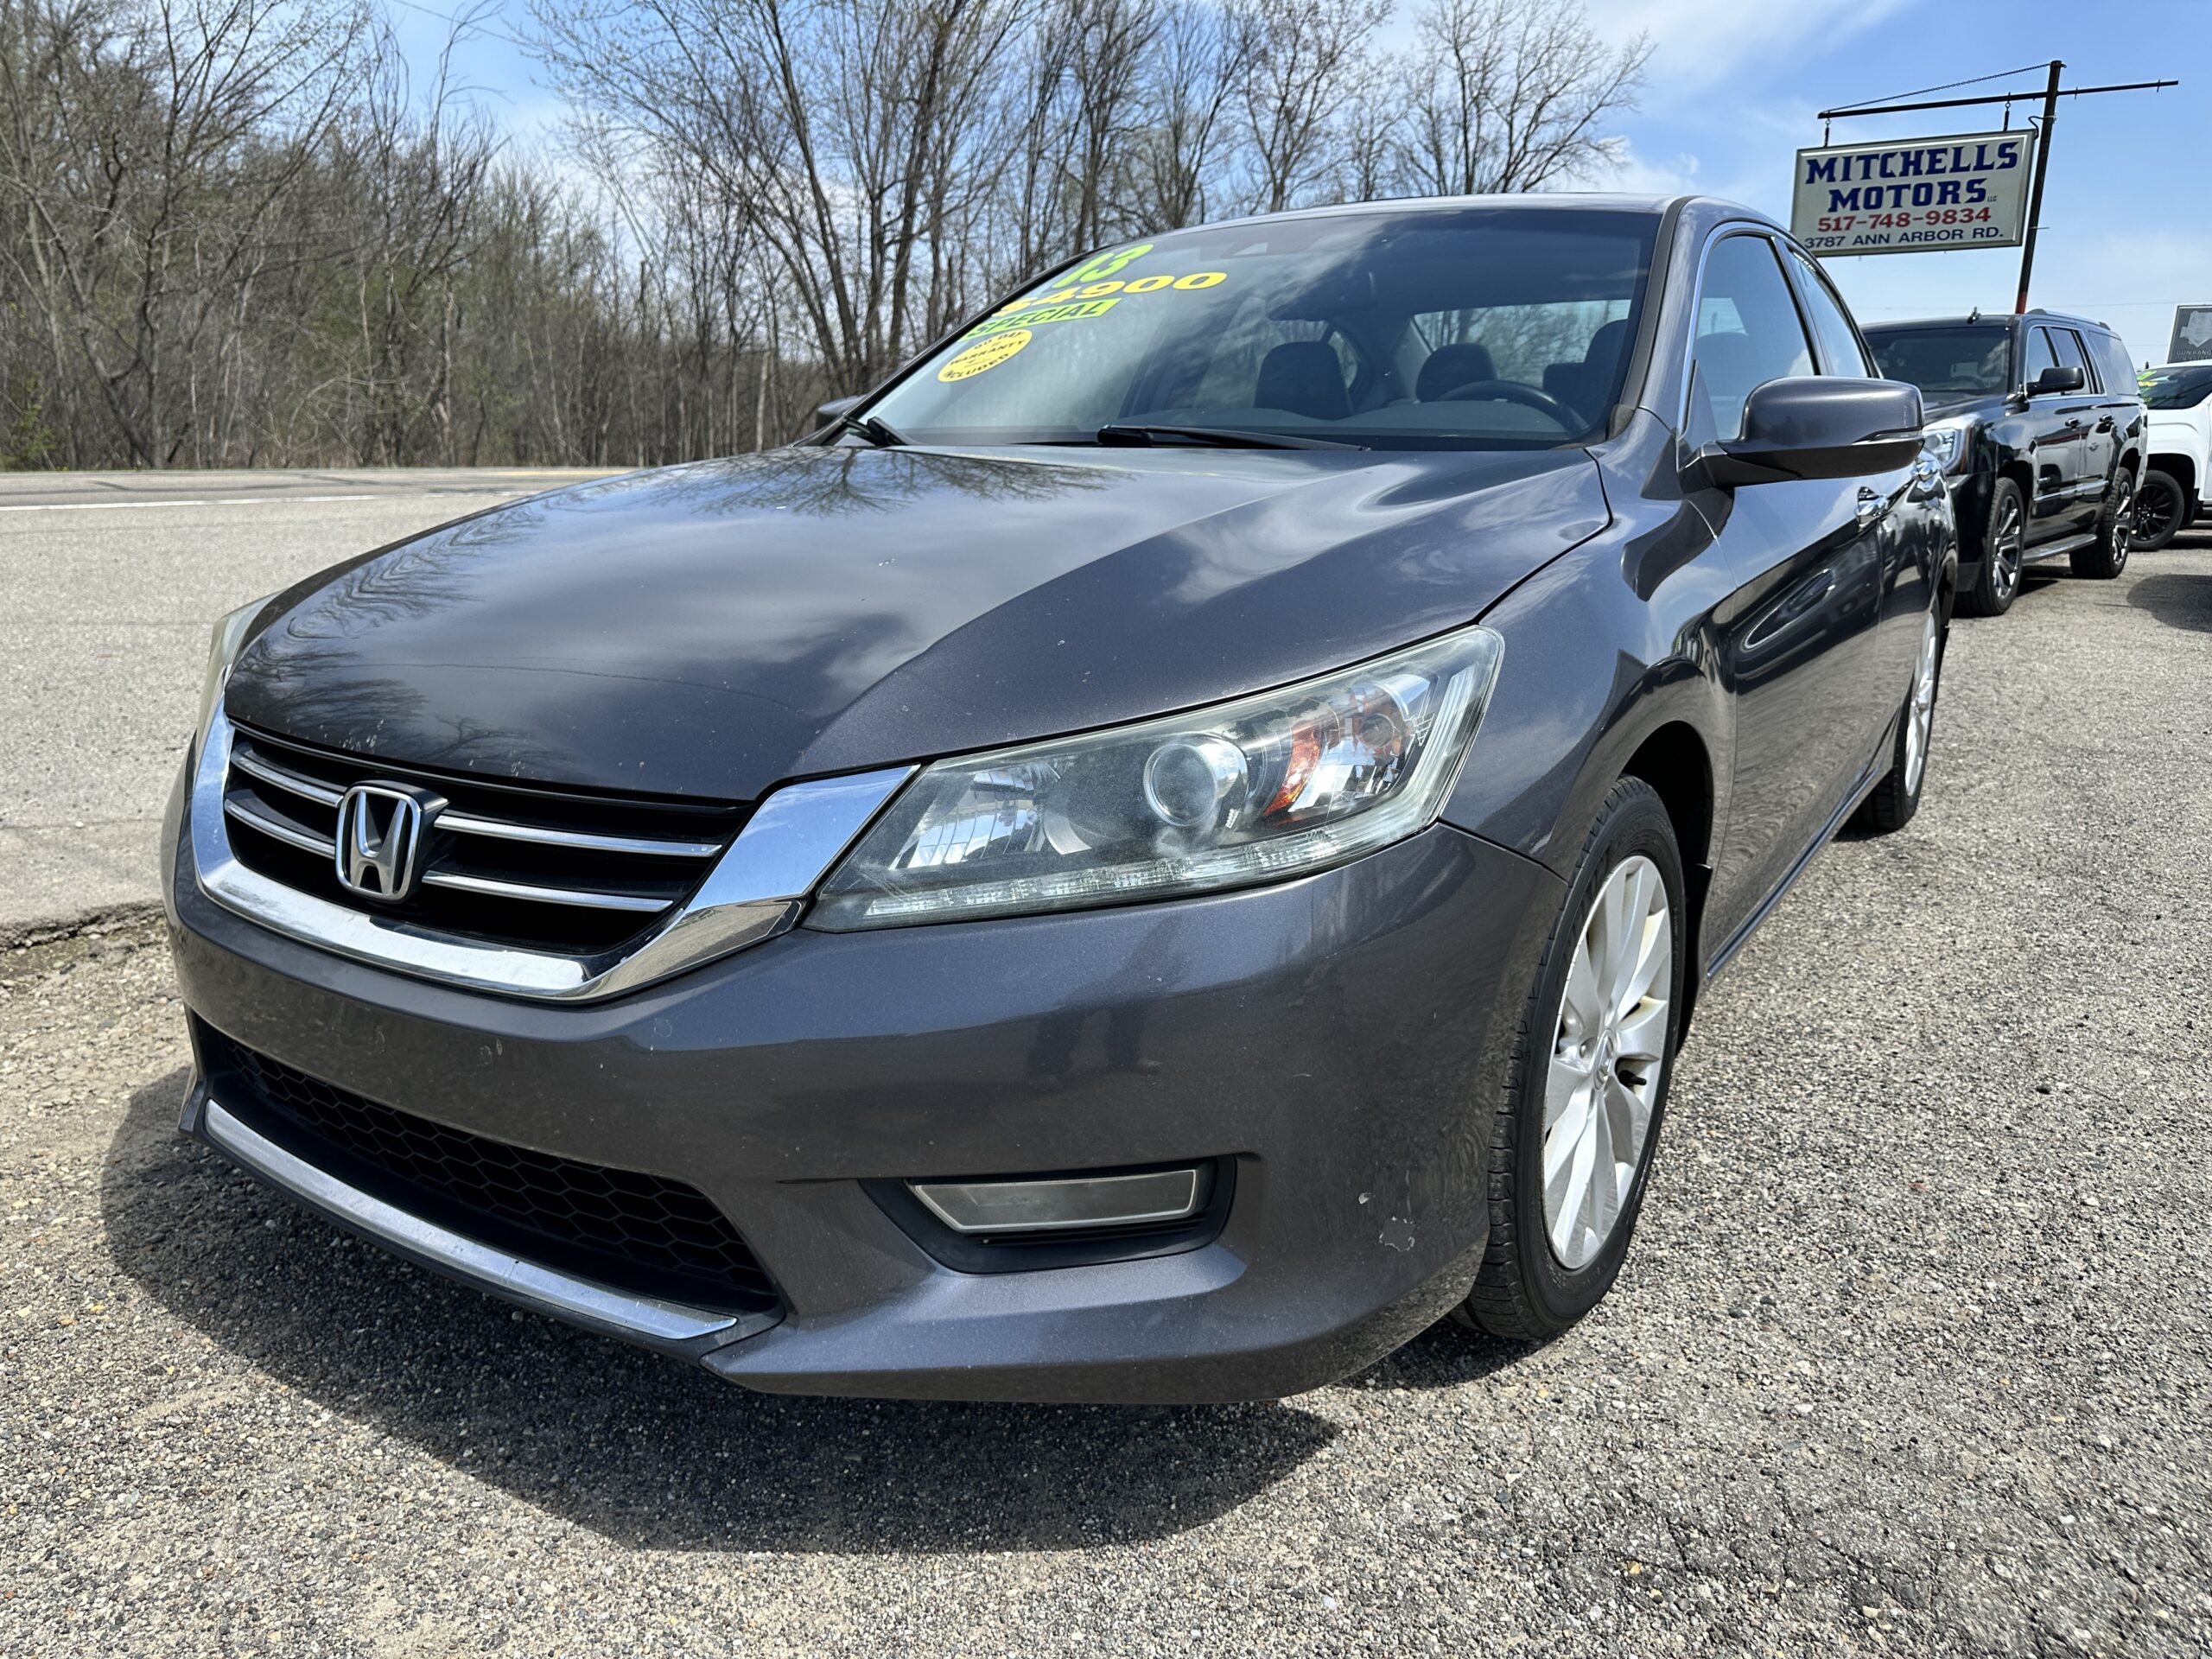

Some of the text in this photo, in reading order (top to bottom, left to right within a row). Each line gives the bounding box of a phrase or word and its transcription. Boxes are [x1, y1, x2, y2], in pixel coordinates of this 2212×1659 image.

[1805, 141, 2019, 184] MITCHELLS
[1827, 177, 1987, 213] MOTORS
[1804, 226, 2004, 249] 3787 ANN ARBOR RD.
[1817, 207, 1992, 232] 517-748-9834
[1052, 244, 1154, 289] 13
[966, 301, 1106, 338] SPECIAL
